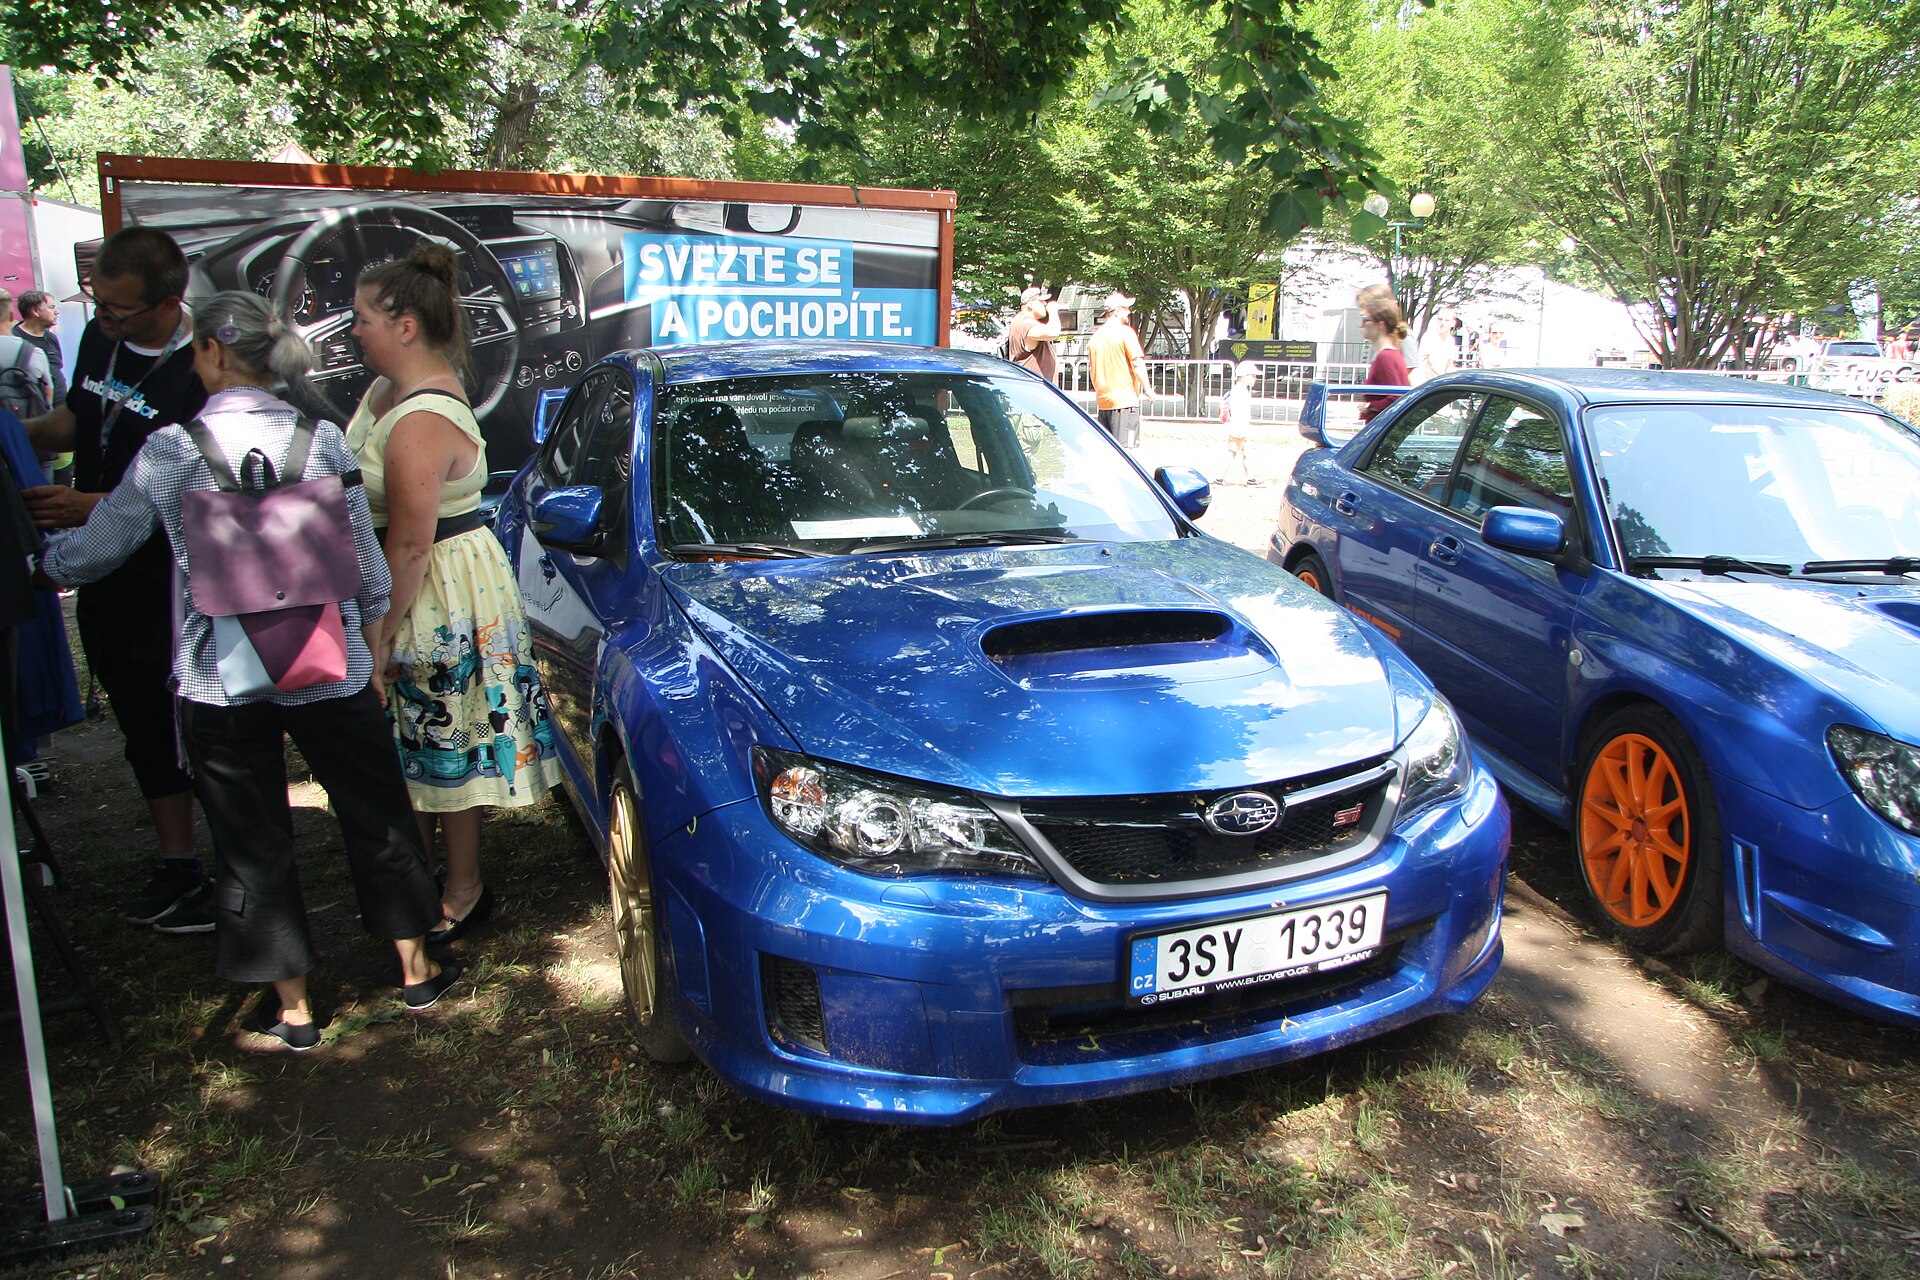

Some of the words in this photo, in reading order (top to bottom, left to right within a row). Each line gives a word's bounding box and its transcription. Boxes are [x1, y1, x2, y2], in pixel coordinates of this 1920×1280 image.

[639, 243, 786, 282] SVEZTE
[796, 247, 841, 283] SE
[659, 300, 689, 338] A
[702, 291, 913, 338] POCHOPÍTE.
[82, 375, 159, 420] Ambasador
[768, 405, 791, 415] počasí
[1167, 927, 1243, 982] 3SY
[1279, 903, 1367, 960] 1339
[1133, 973, 1154, 991] CZ
[1158, 985, 1205, 1002] SUBARU
[1215, 964, 1309, 991] www.autovero.cz
